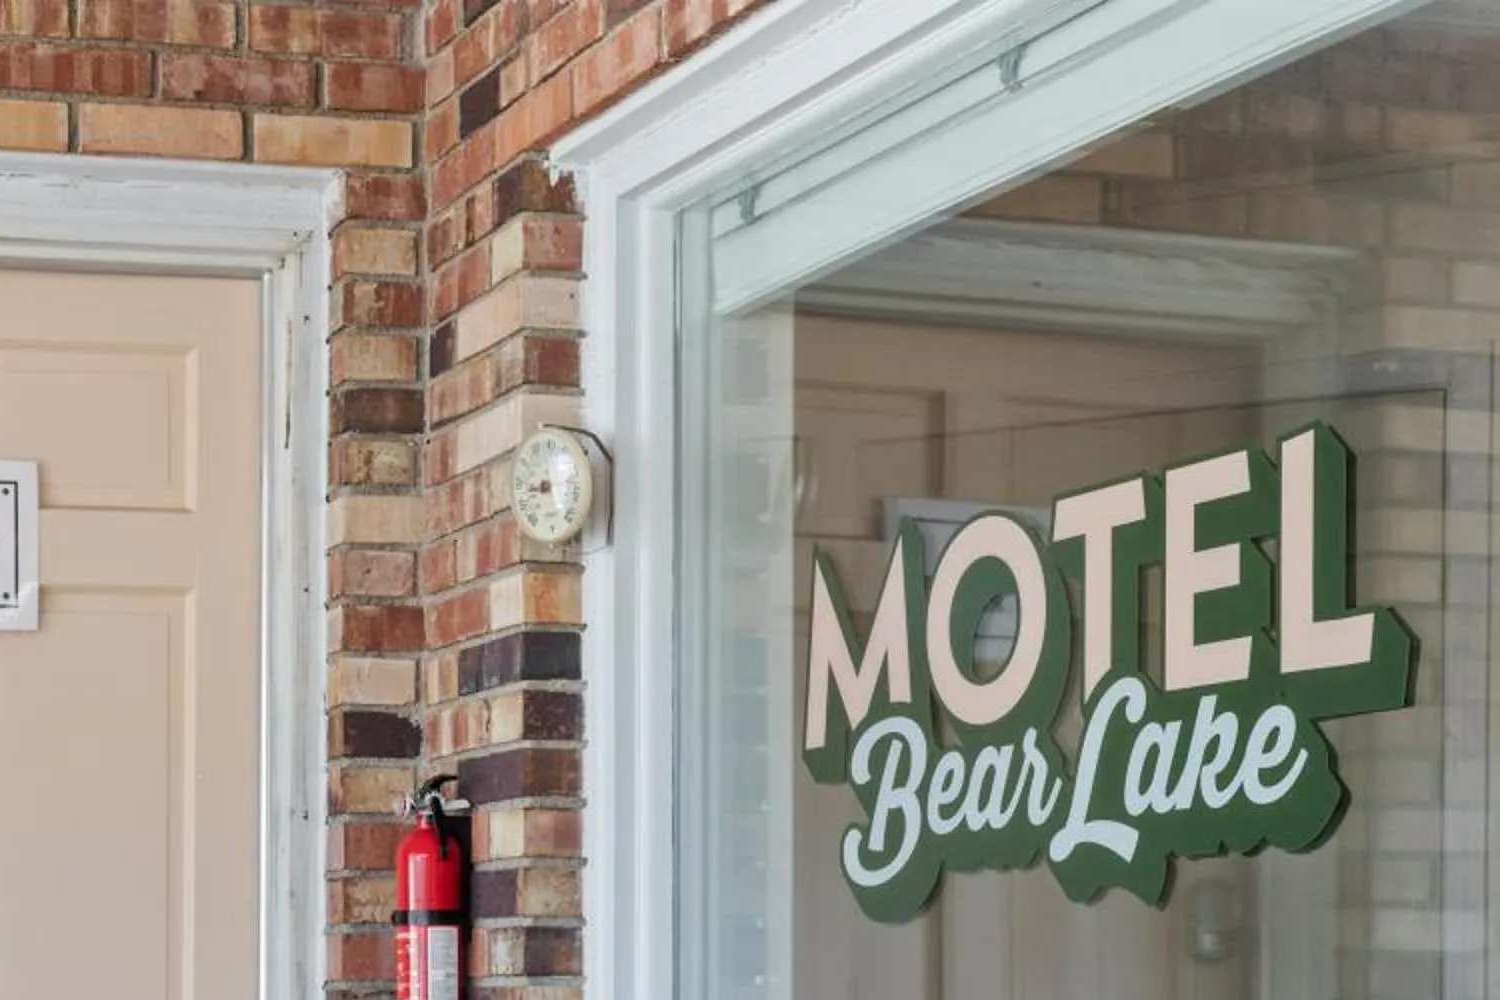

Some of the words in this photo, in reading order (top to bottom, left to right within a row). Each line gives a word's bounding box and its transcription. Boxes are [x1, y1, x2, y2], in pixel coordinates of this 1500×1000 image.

[804, 427, 1375, 751] MOTEL
[842, 715, 1064, 888] Bear
[1048, 676, 1308, 864] Lake
